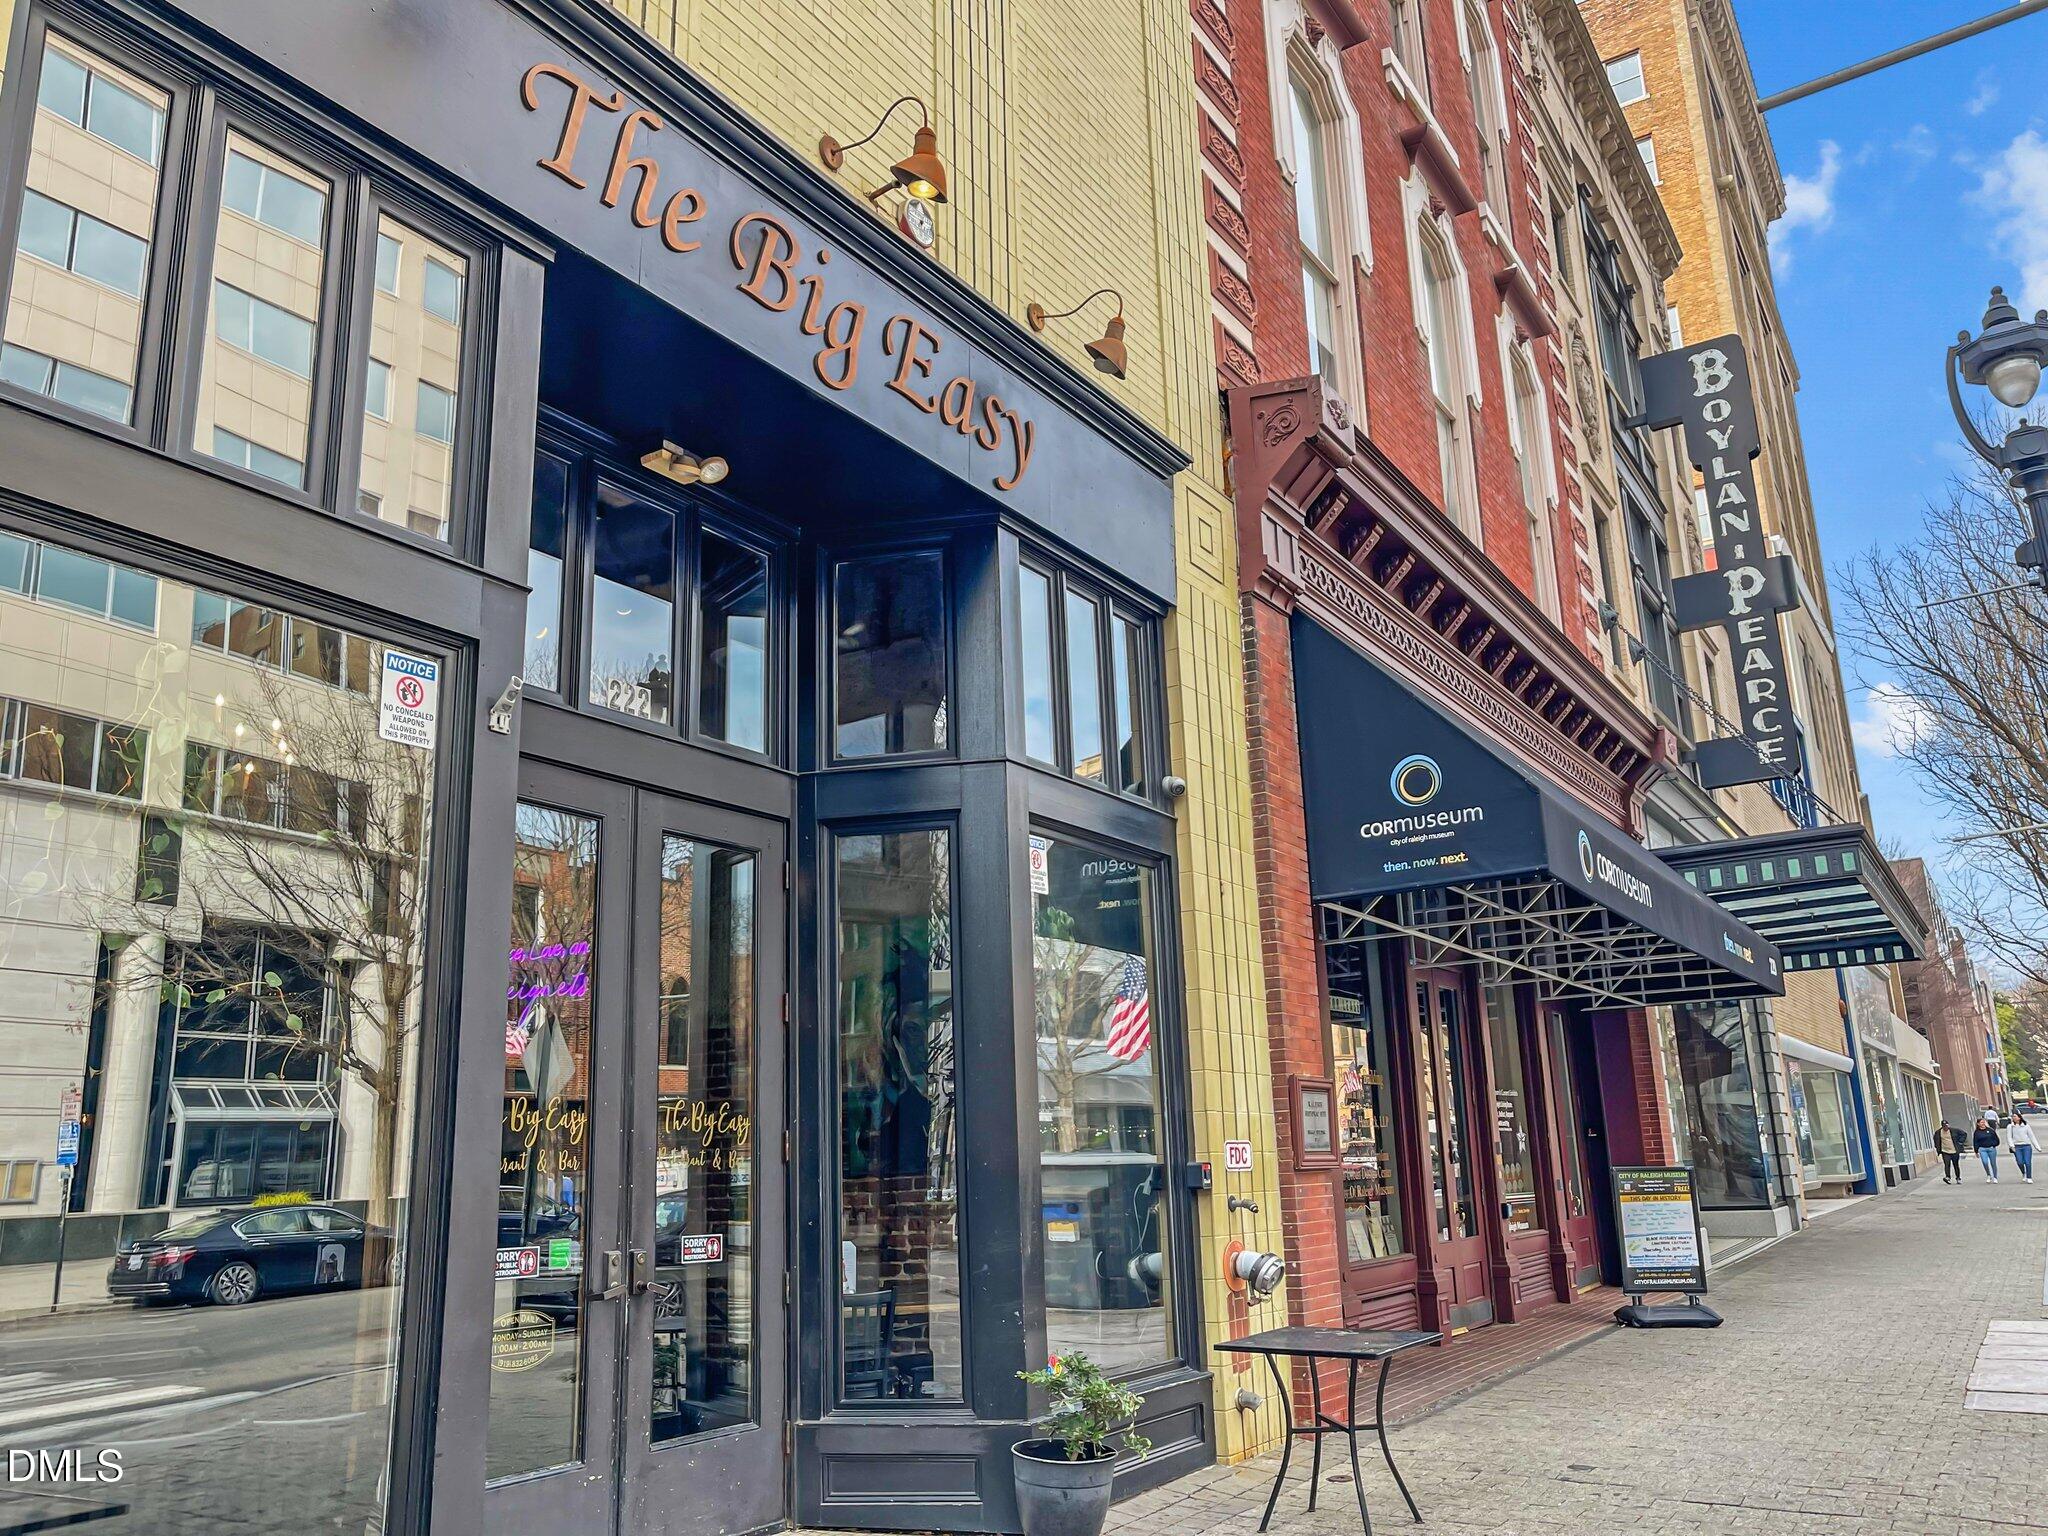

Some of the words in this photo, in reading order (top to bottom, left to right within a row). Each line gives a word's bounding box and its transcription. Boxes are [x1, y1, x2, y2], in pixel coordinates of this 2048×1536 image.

[520, 63, 708, 252] The
[729, 211, 867, 390] Big
[883, 314, 1035, 490] Easy
[388, 655, 434, 678] NOTICE
[609, 679, 649, 718] 222
[383, 703, 394, 711] NO
[395, 706, 434, 722] CONCEALED
[392, 714, 425, 728] WEAPONS
[384, 729, 398, 738] THIS
[399, 733, 430, 745] PROPERTY
[388, 723, 417, 735] ALLOWED
[418, 729, 427, 737] ON
[1390, 838, 1401, 846] city
[1401, 836, 1409, 844] of
[1408, 834, 1428, 843] raleigh
[1428, 831, 1455, 840] museum
[1383, 861, 1411, 873] then.
[1413, 857, 1439, 868] now.
[1440, 852, 1469, 865] next.
[510, 1096, 544, 1148] Big
[545, 1096, 588, 1145] Easy
[658, 1099, 691, 1134] The
[691, 1101, 718, 1147] Big
[717, 1102, 751, 1146] Easy
[536, 1149, 547, 1174] &
[558, 1149, 580, 1171] Bar
[712, 1148, 721, 1170] &
[1229, 1146, 1248, 1165] FDC
[684, 1237, 708, 1248] SORRY
[499, 1261, 518, 1269] PUBLIC
[500, 1315, 519, 1328] OPEN
[520, 1313, 540, 1323] DAILY
